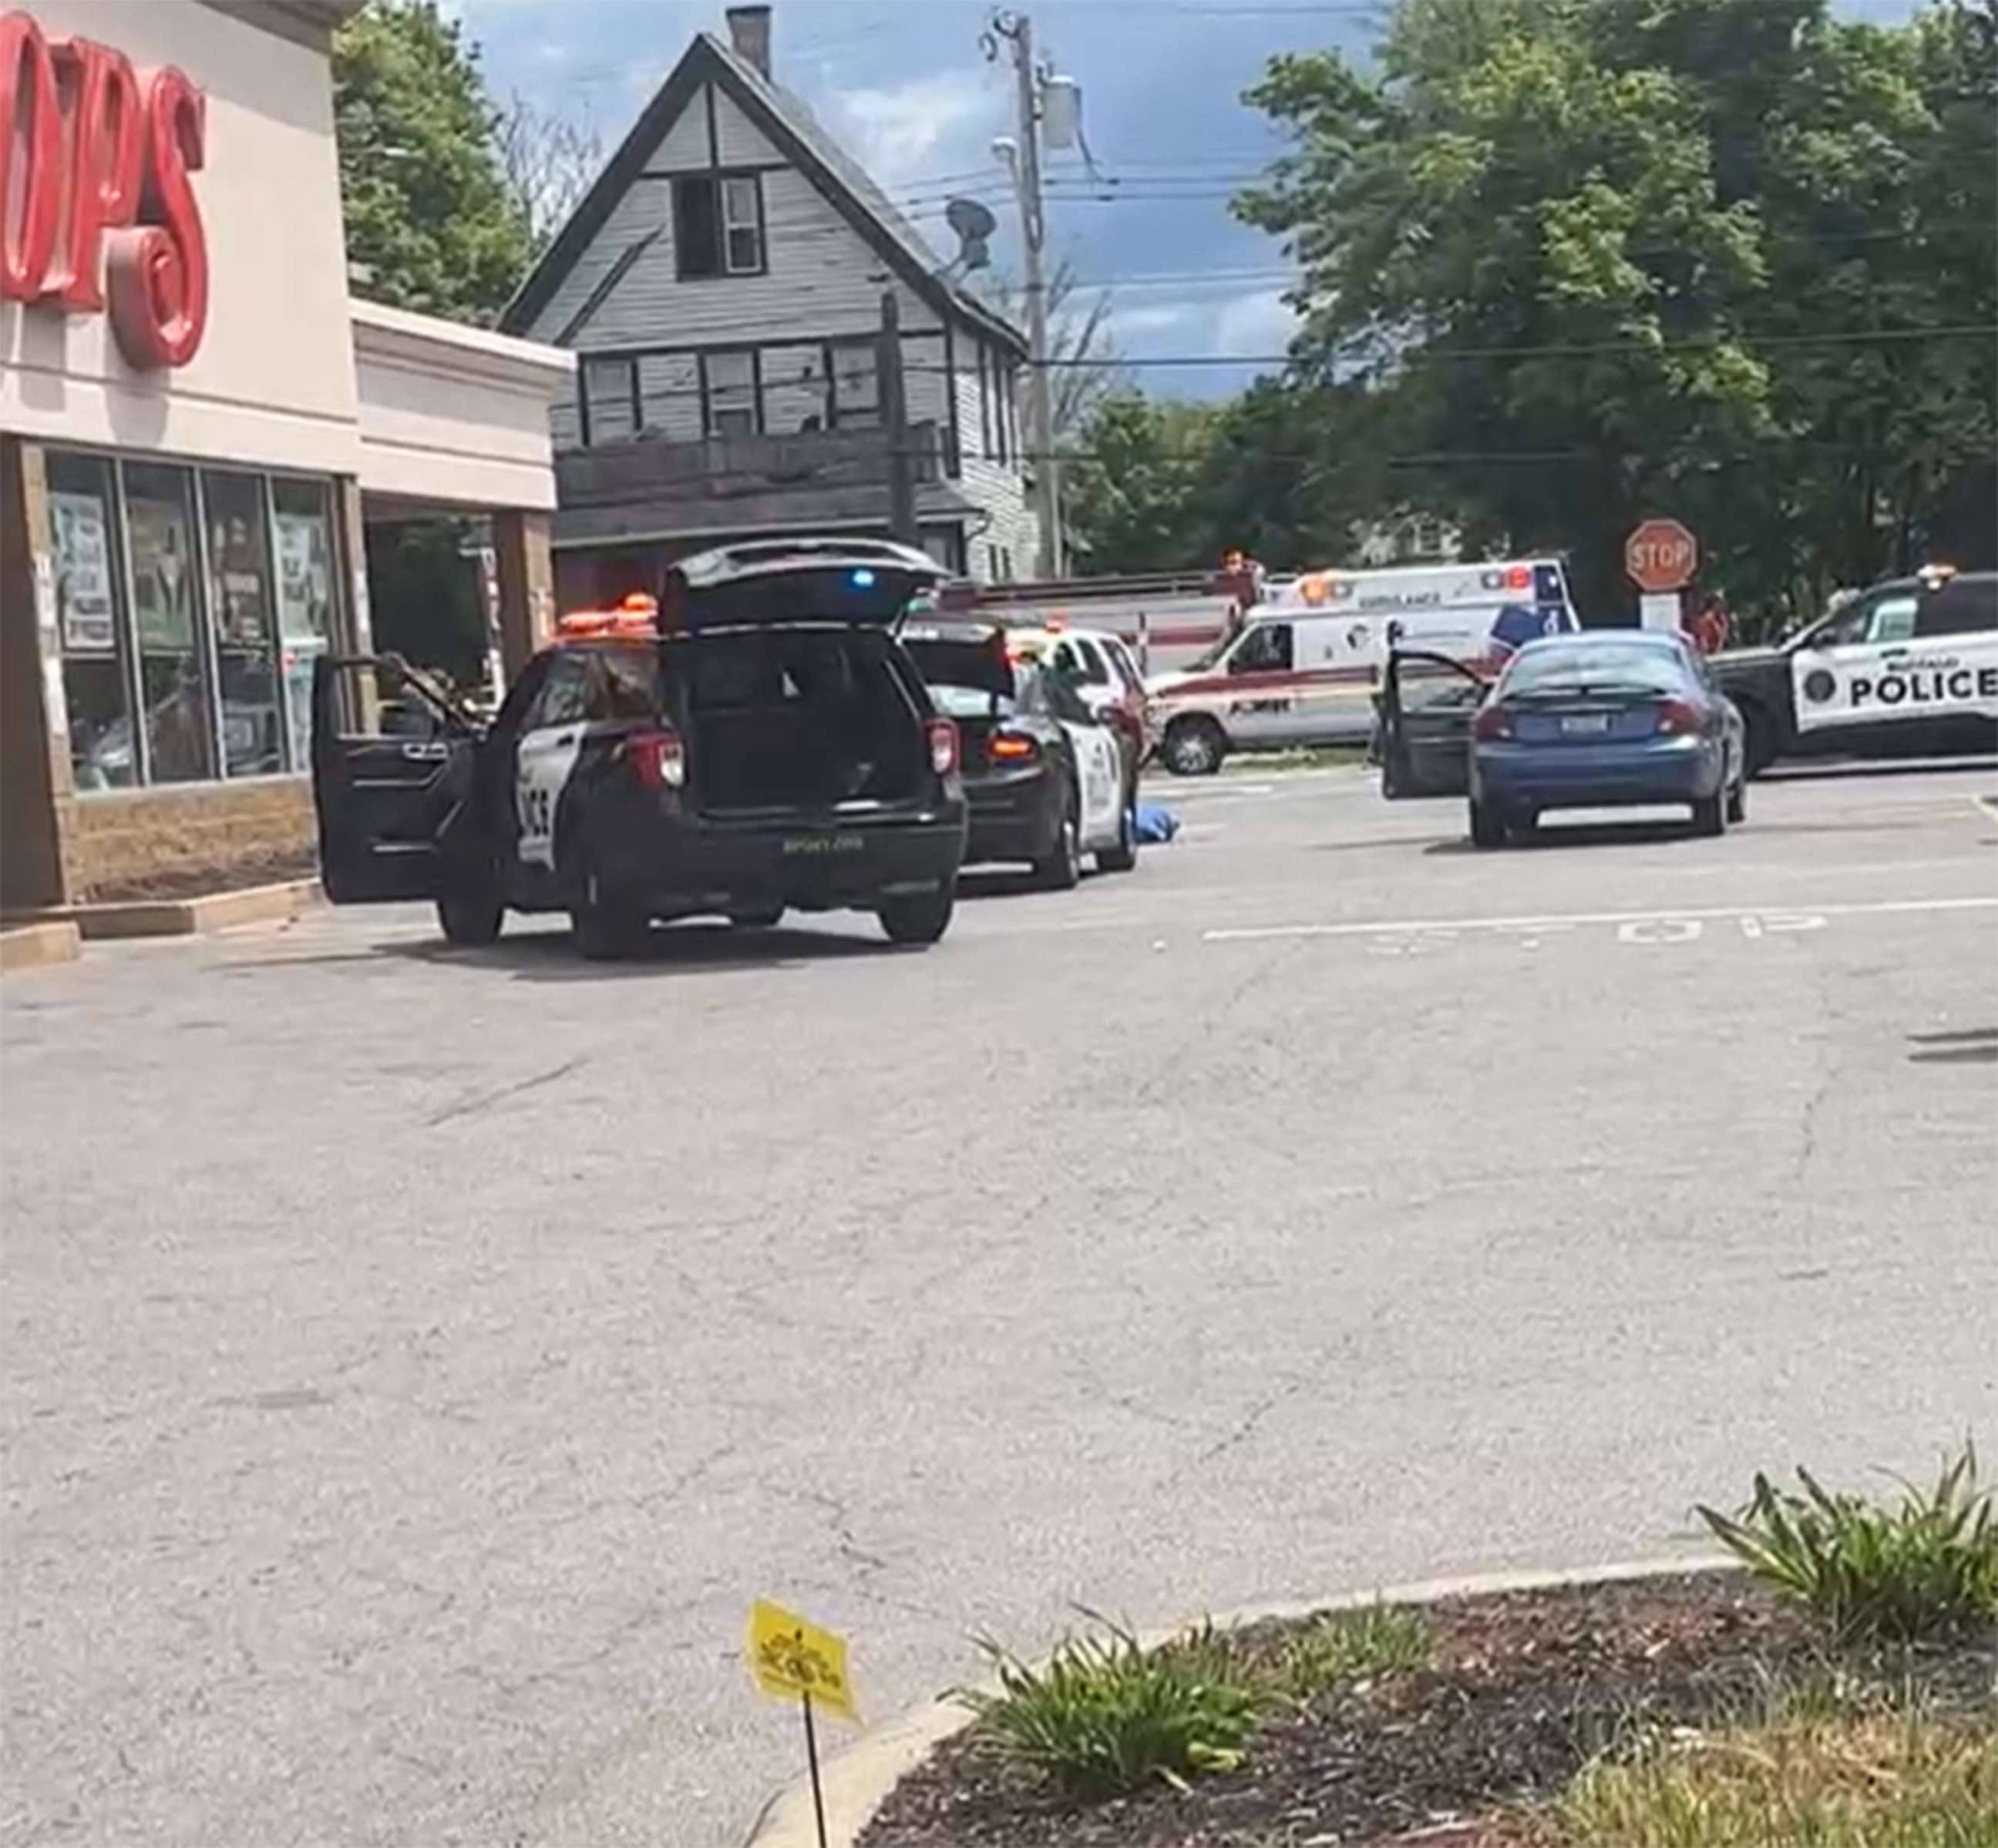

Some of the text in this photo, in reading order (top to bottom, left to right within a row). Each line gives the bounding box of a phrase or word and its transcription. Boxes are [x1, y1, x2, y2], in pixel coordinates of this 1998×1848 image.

[0, 11, 208, 368] OPS
[1632, 540, 1690, 570] STOP
[1851, 668, 1998, 707] POLICE
